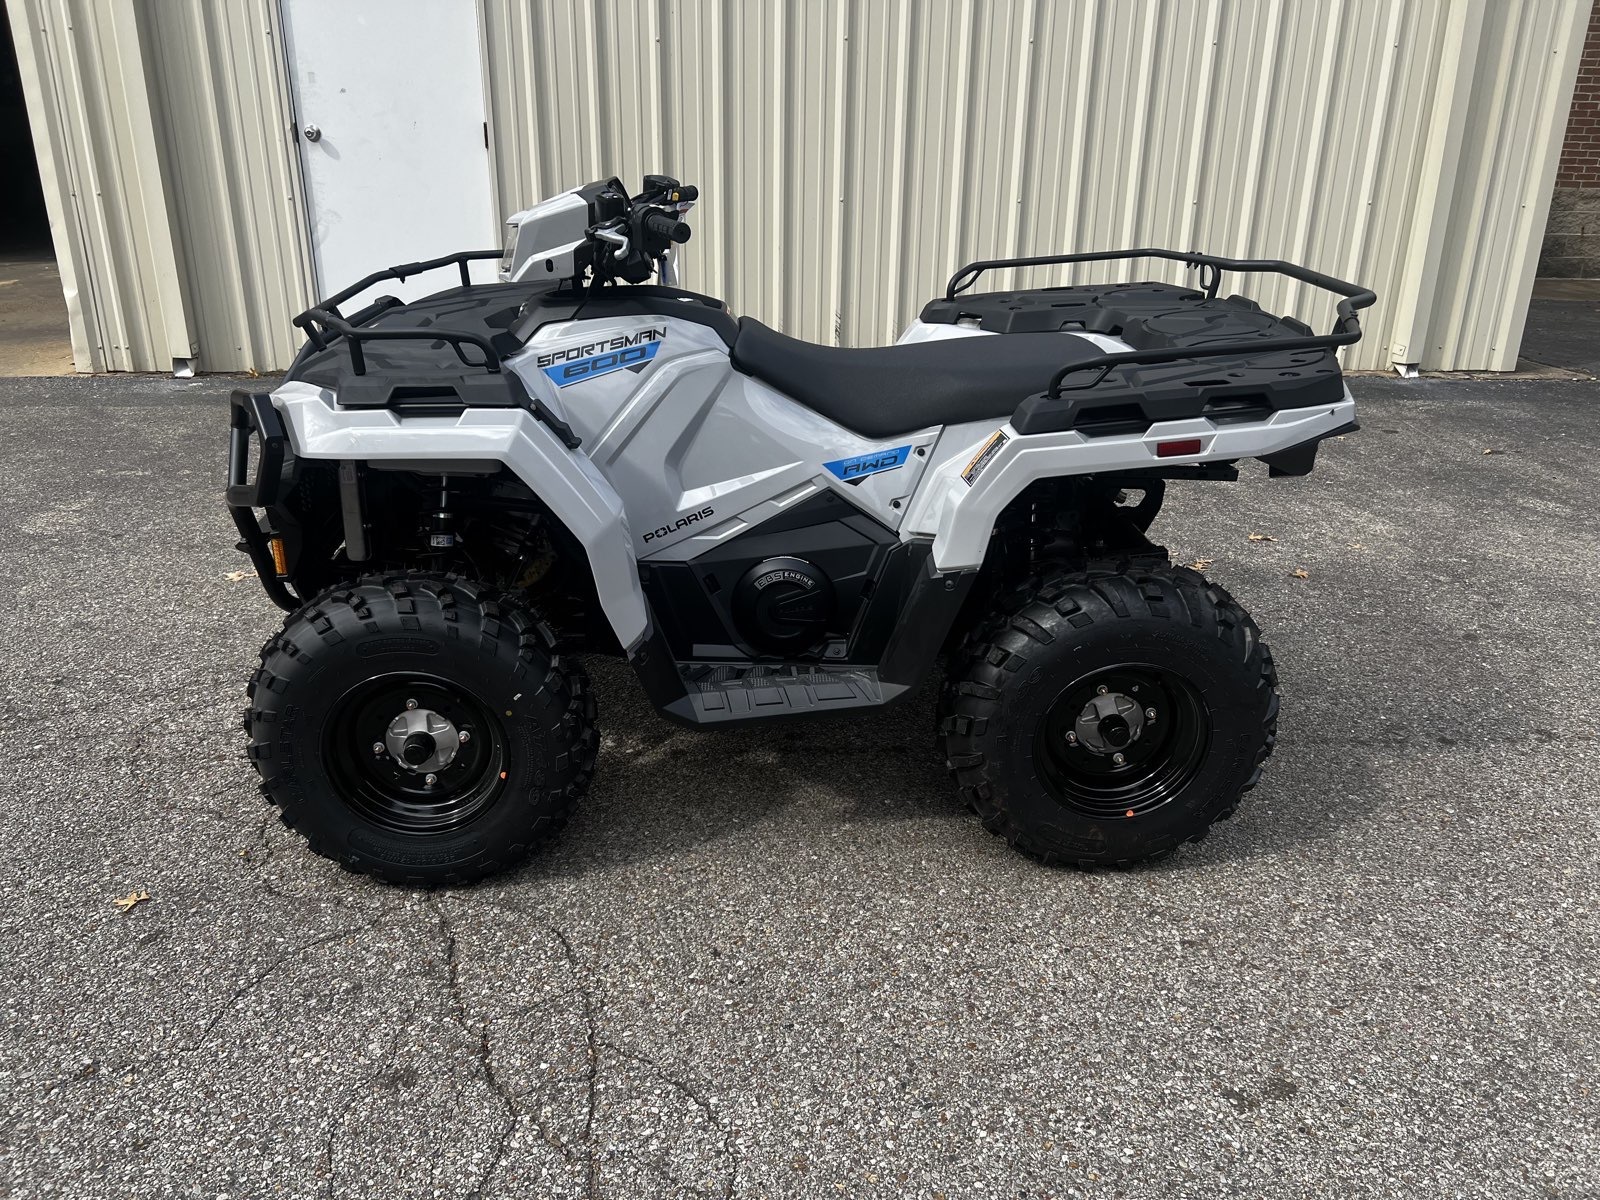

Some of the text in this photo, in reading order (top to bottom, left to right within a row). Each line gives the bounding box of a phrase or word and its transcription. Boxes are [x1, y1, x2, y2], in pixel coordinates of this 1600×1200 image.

[537, 326, 667, 368] SPORTSMAN
[563, 347, 647, 379] 600
[843, 455, 898, 475] AWD
[642, 506, 715, 544] POLARIS
[784, 571, 813, 586] ENGINE
